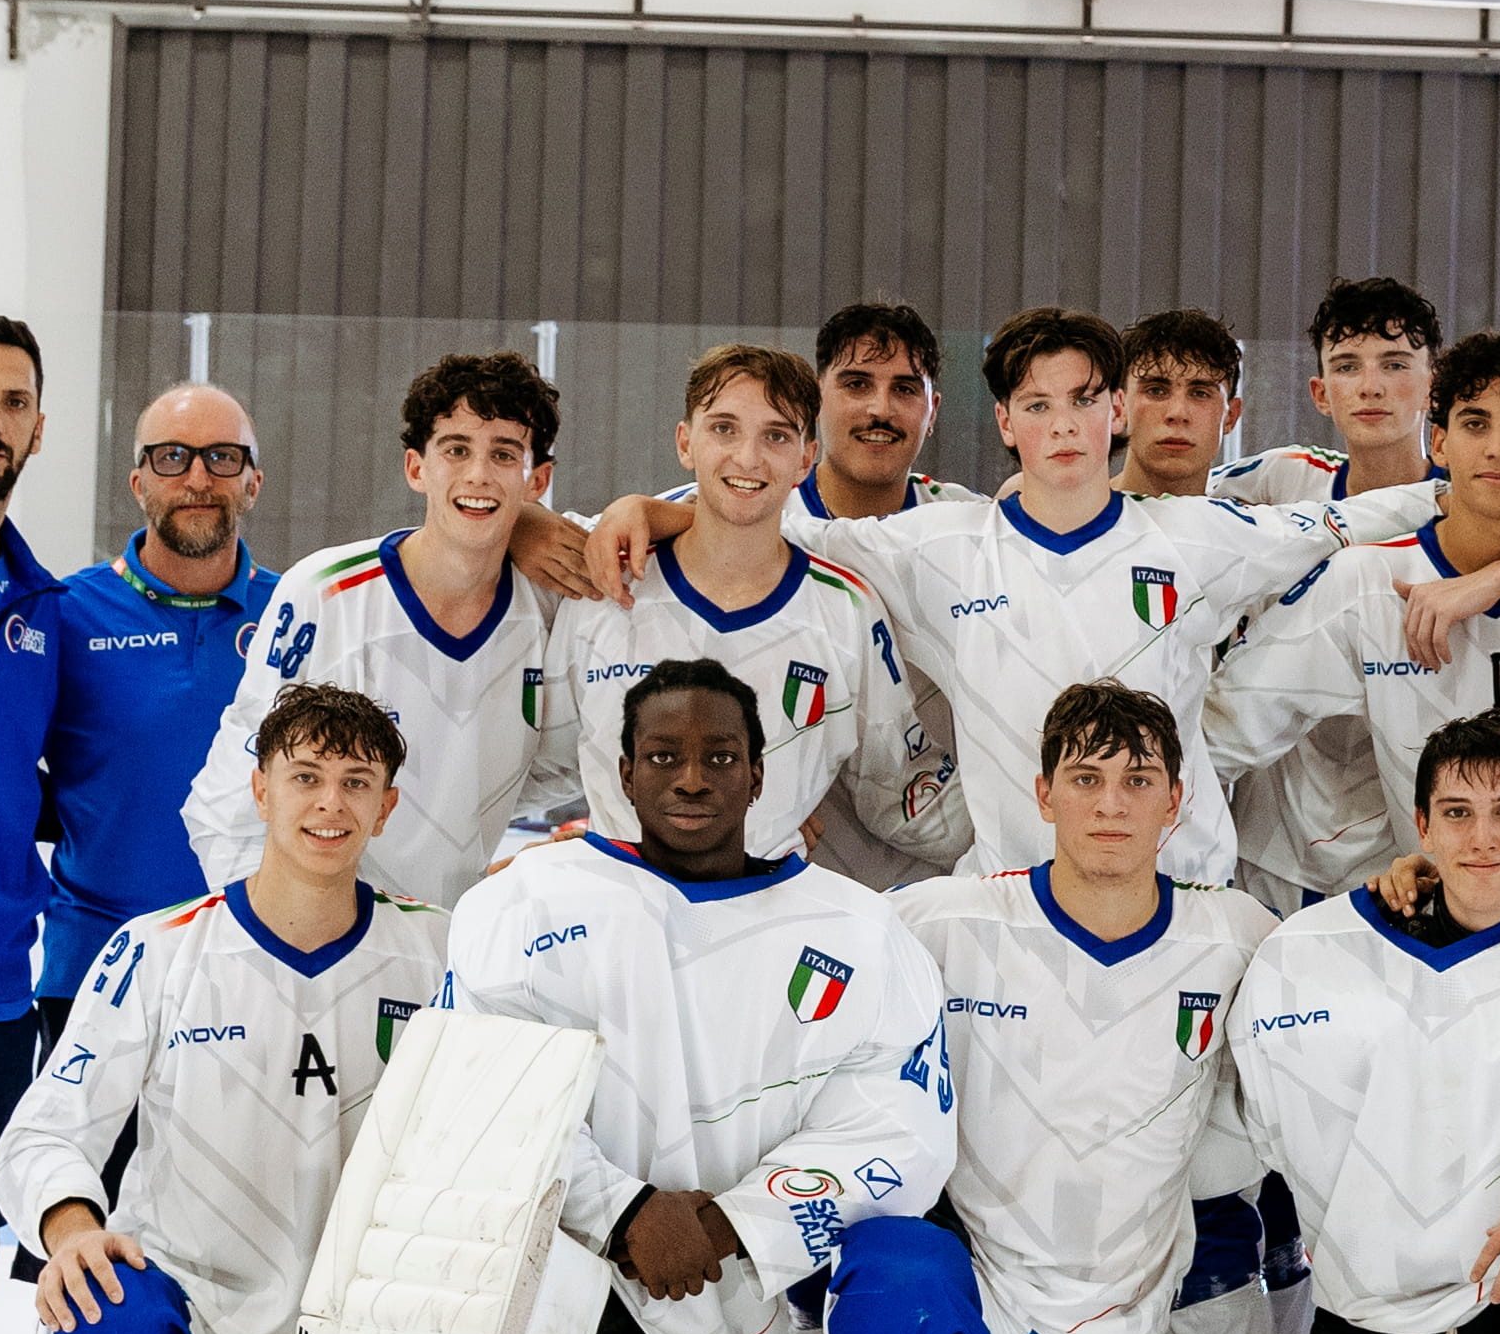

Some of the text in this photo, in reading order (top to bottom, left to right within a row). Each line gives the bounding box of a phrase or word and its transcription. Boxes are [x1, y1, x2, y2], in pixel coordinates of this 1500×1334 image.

[88, 632, 179, 652] GIVOVA
[267, 601, 317, 679] 28
[92, 930, 145, 1009] 21
[804, 951, 846, 982] ITALIA
[947, 998, 1028, 1020] GIVOVA
[1183, 996, 1218, 1010] ITALIA
[167, 1025, 246, 1050] IVOVA
[1252, 1009, 1331, 1038] IVOVA
[291, 1032, 338, 1097] A
[789, 1200, 832, 1267] ITALIA
